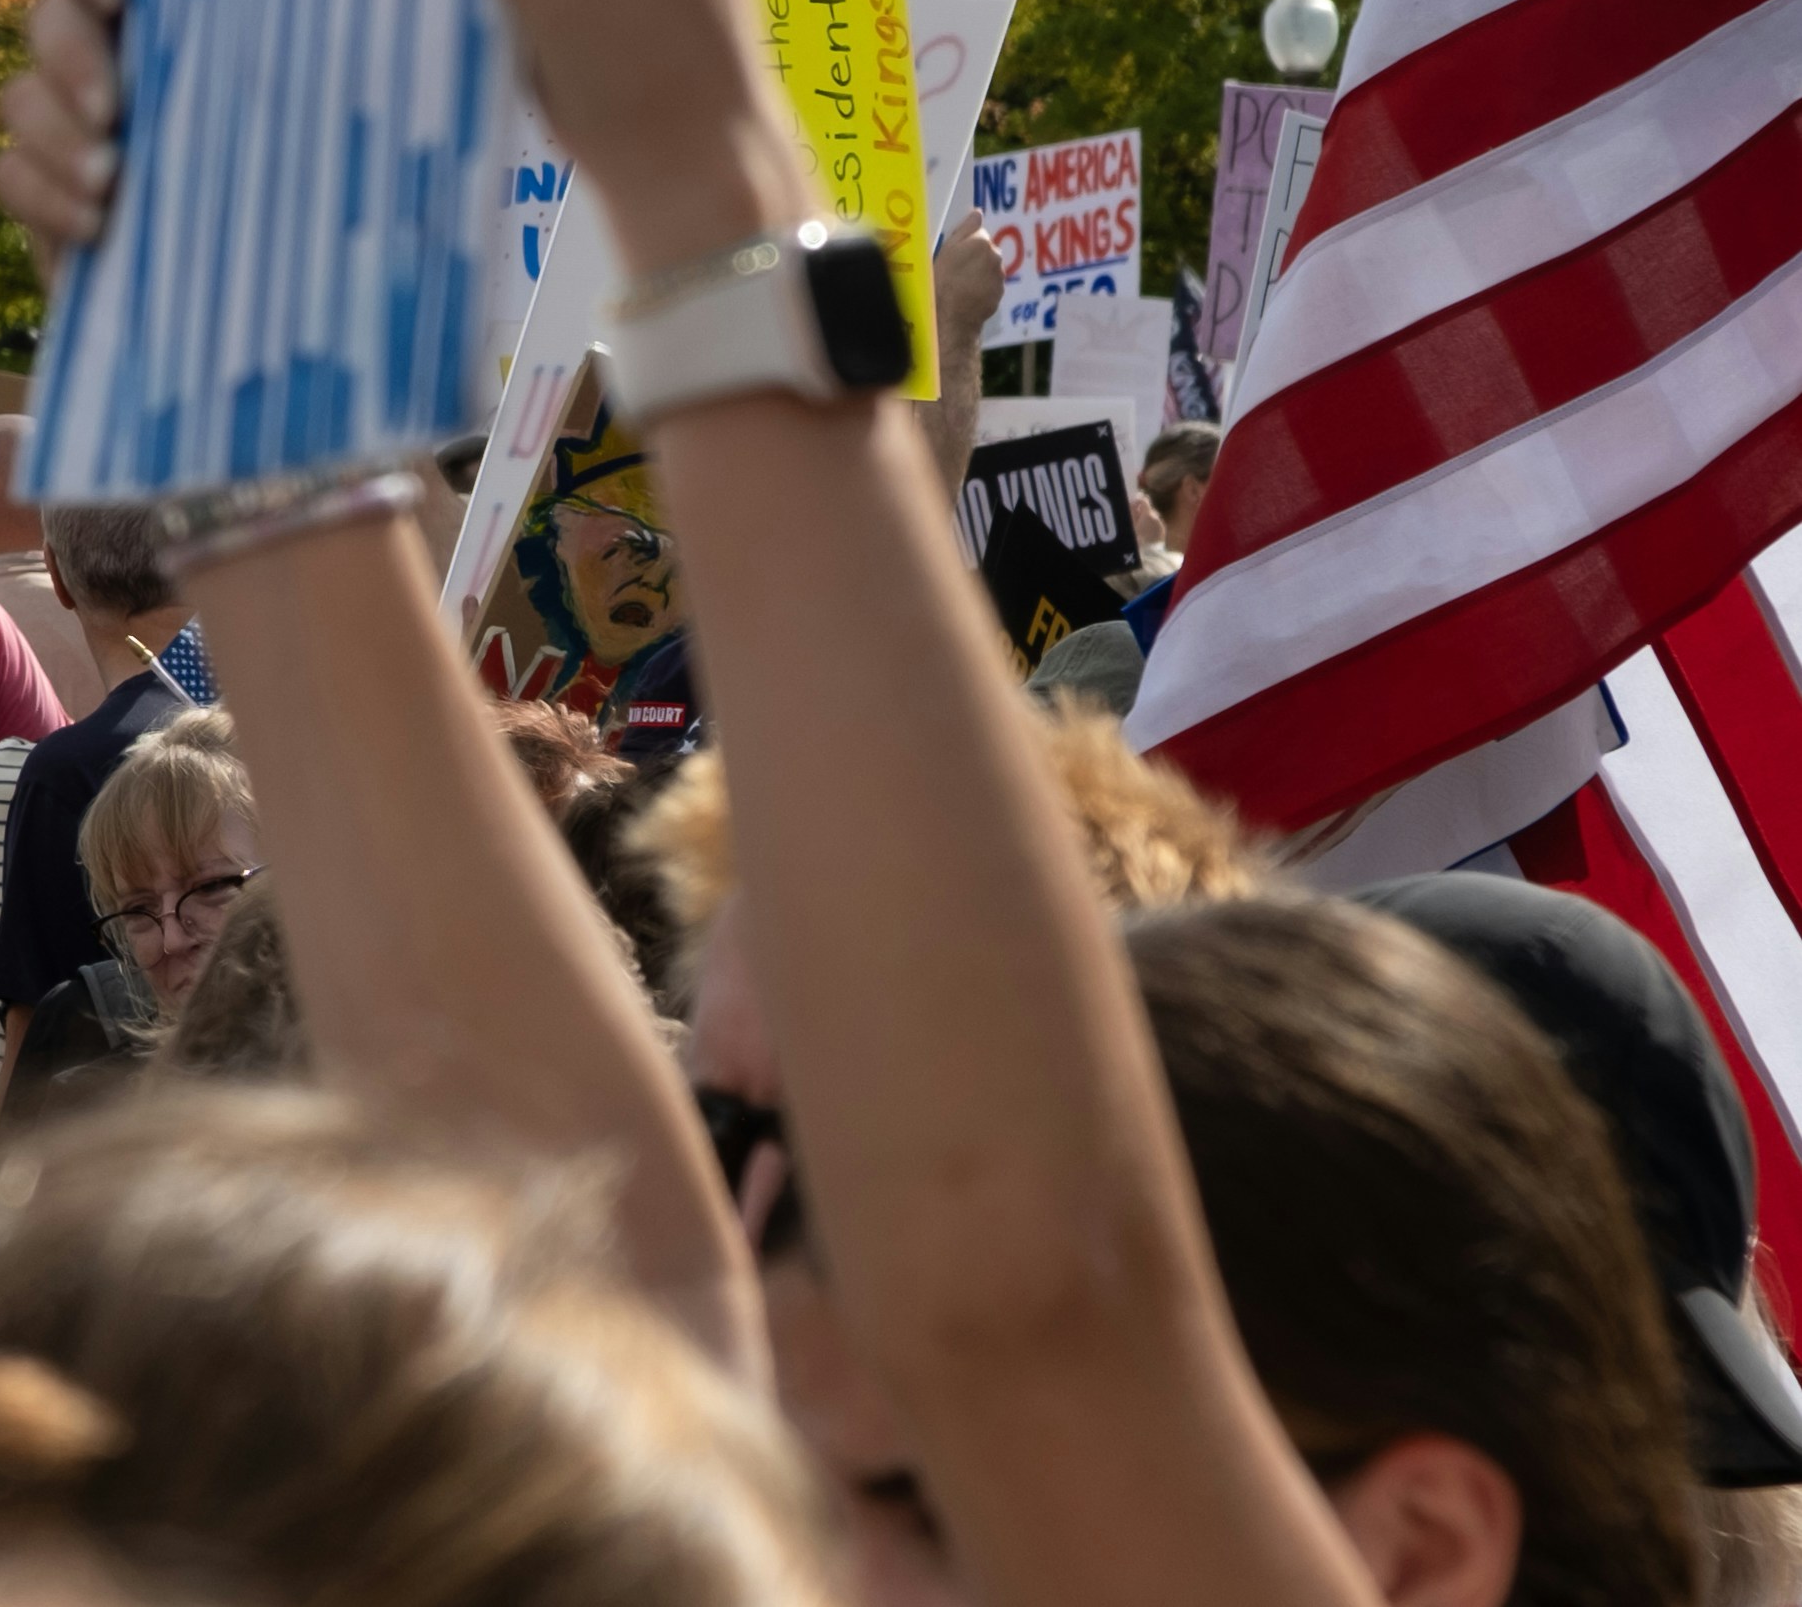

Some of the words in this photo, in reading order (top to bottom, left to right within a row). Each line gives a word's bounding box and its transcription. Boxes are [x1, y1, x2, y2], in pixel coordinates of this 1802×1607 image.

[974, 159, 1017, 213] ING
[1023, 137, 1138, 215] AMERICA
[1034, 198, 1136, 277] KINGS
[642, 705, 684, 723] COURT
